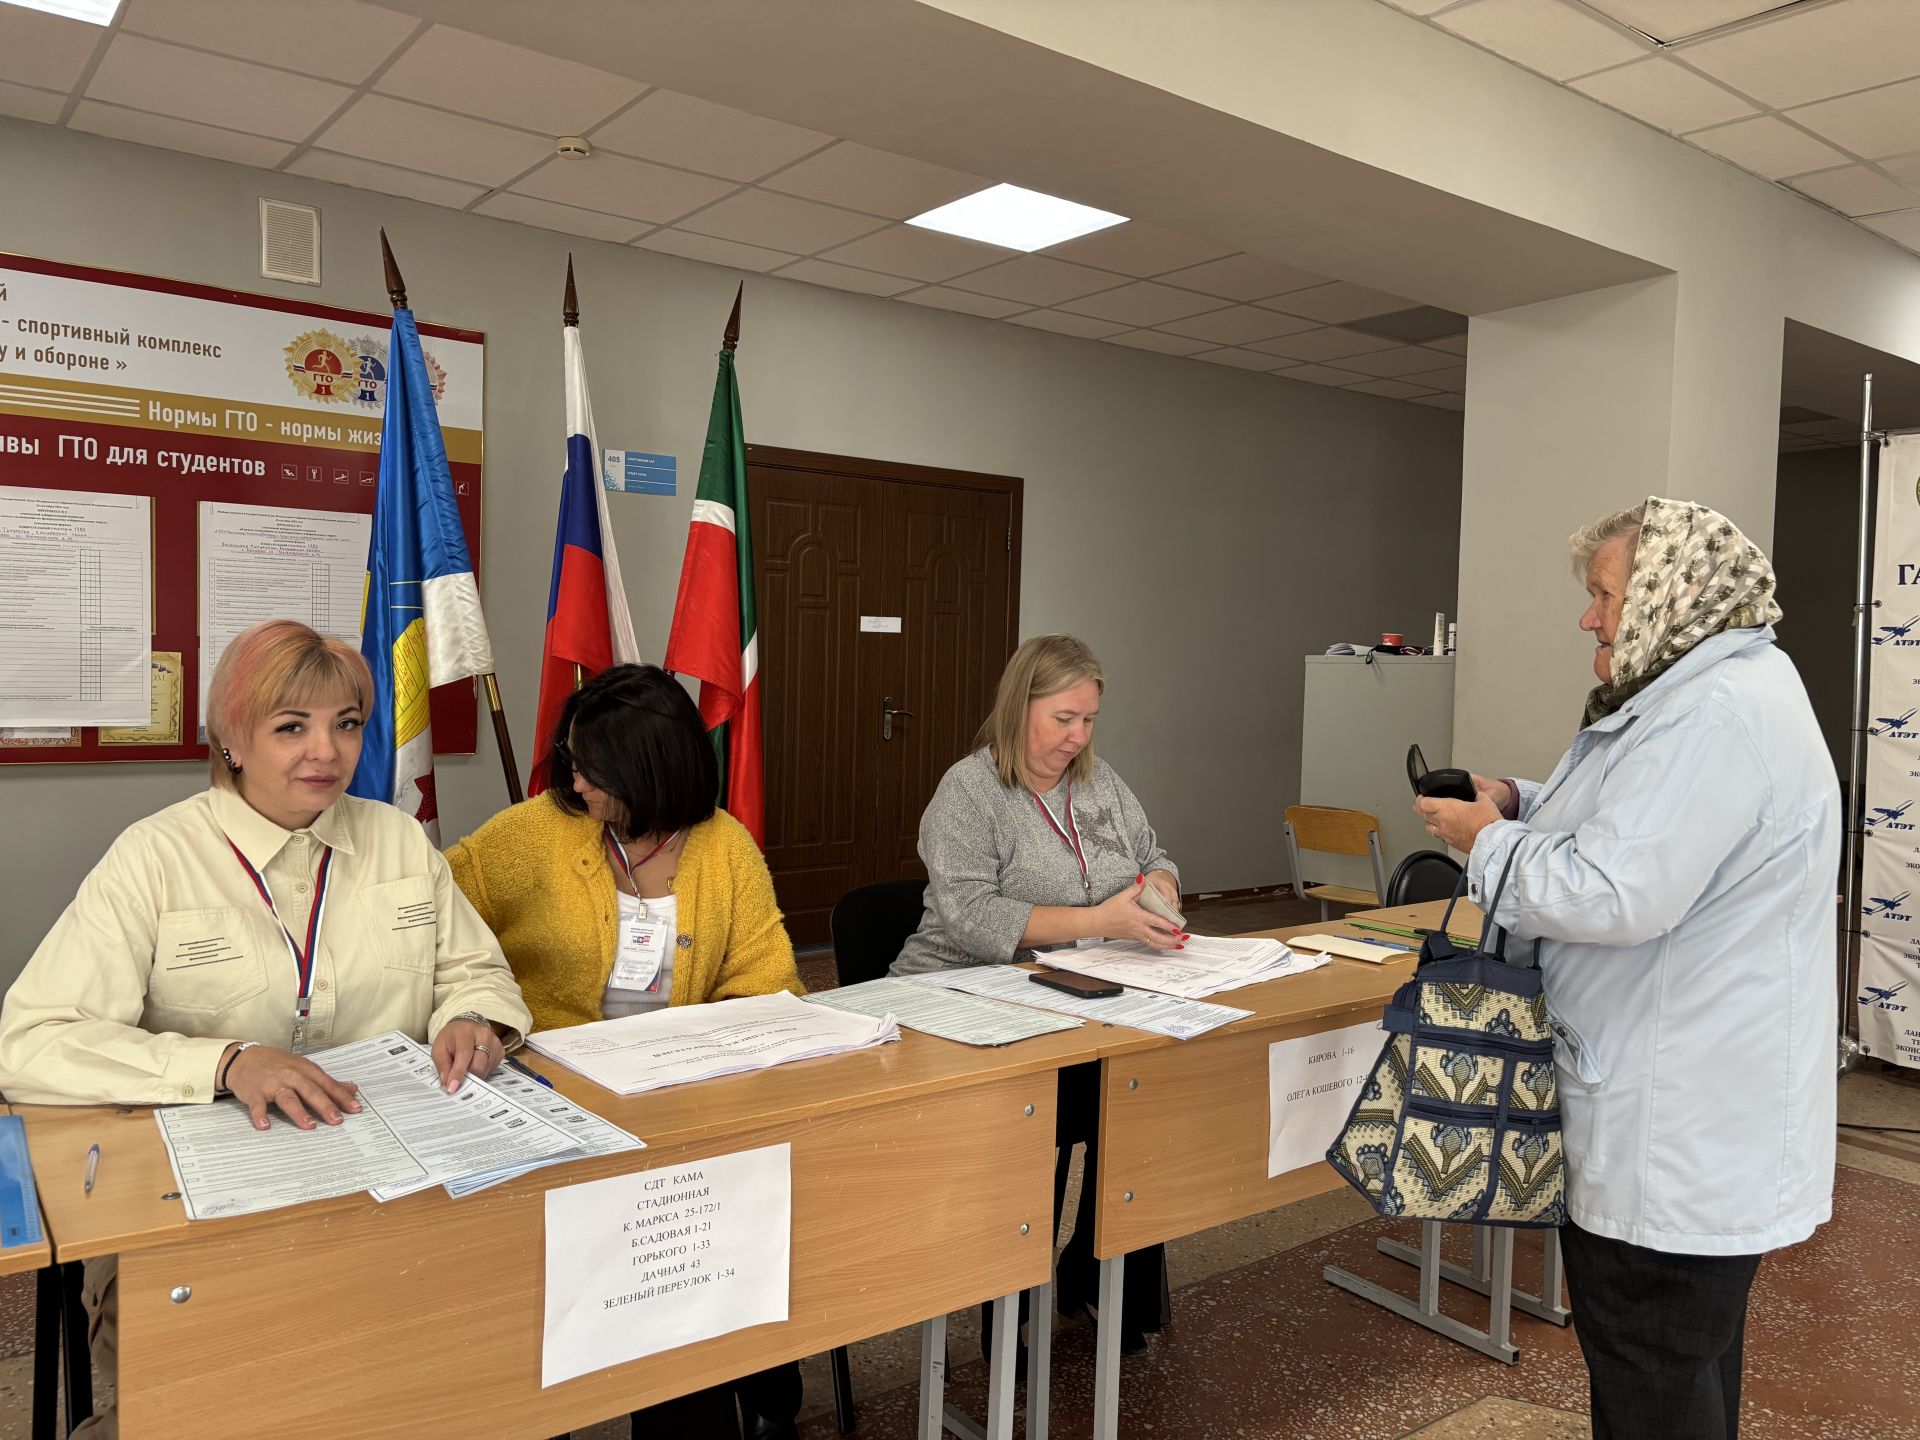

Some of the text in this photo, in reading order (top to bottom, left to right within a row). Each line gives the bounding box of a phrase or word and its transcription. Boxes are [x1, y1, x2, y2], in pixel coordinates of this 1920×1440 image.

[17, 318, 130, 346] спортивный
[137, 334, 222, 358] комплекс
[15, 346, 26, 361] и
[34, 345, 110, 371] обороне
[313, 373, 334, 384] ГТО
[148, 400, 217, 429] Нормы
[225, 409, 258, 432] ГТО
[280, 420, 342, 443] нормы
[57, 434, 98, 461] ГТО
[106, 445, 148, 466] для
[157, 450, 267, 476] студентов
[607, 455, 621, 463] 405
[1308, 1046, 1355, 1065] КИРОВА 1-16
[1286, 1087, 1310, 1102] ОЛЕГА
[1312, 1077, 1353, 1096] КОШЕВОГО
[644, 1171, 704, 1191] СДТ КАМА
[637, 1187, 710, 1211] СТАДИОННАЯ
[623, 1202, 721, 1233] К. МАРКСА 25-172/1
[631, 1221, 712, 1248] Б.САДОВАЯ 1-21
[632, 1240, 711, 1266] ГОРЬКОГО 1-33
[641, 1259, 701, 1283] ДАЧНАЯ 43
[603, 1268, 735, 1310] ЗЕЛЕНЫЙ ПЕРЕУЛОК 1-34
